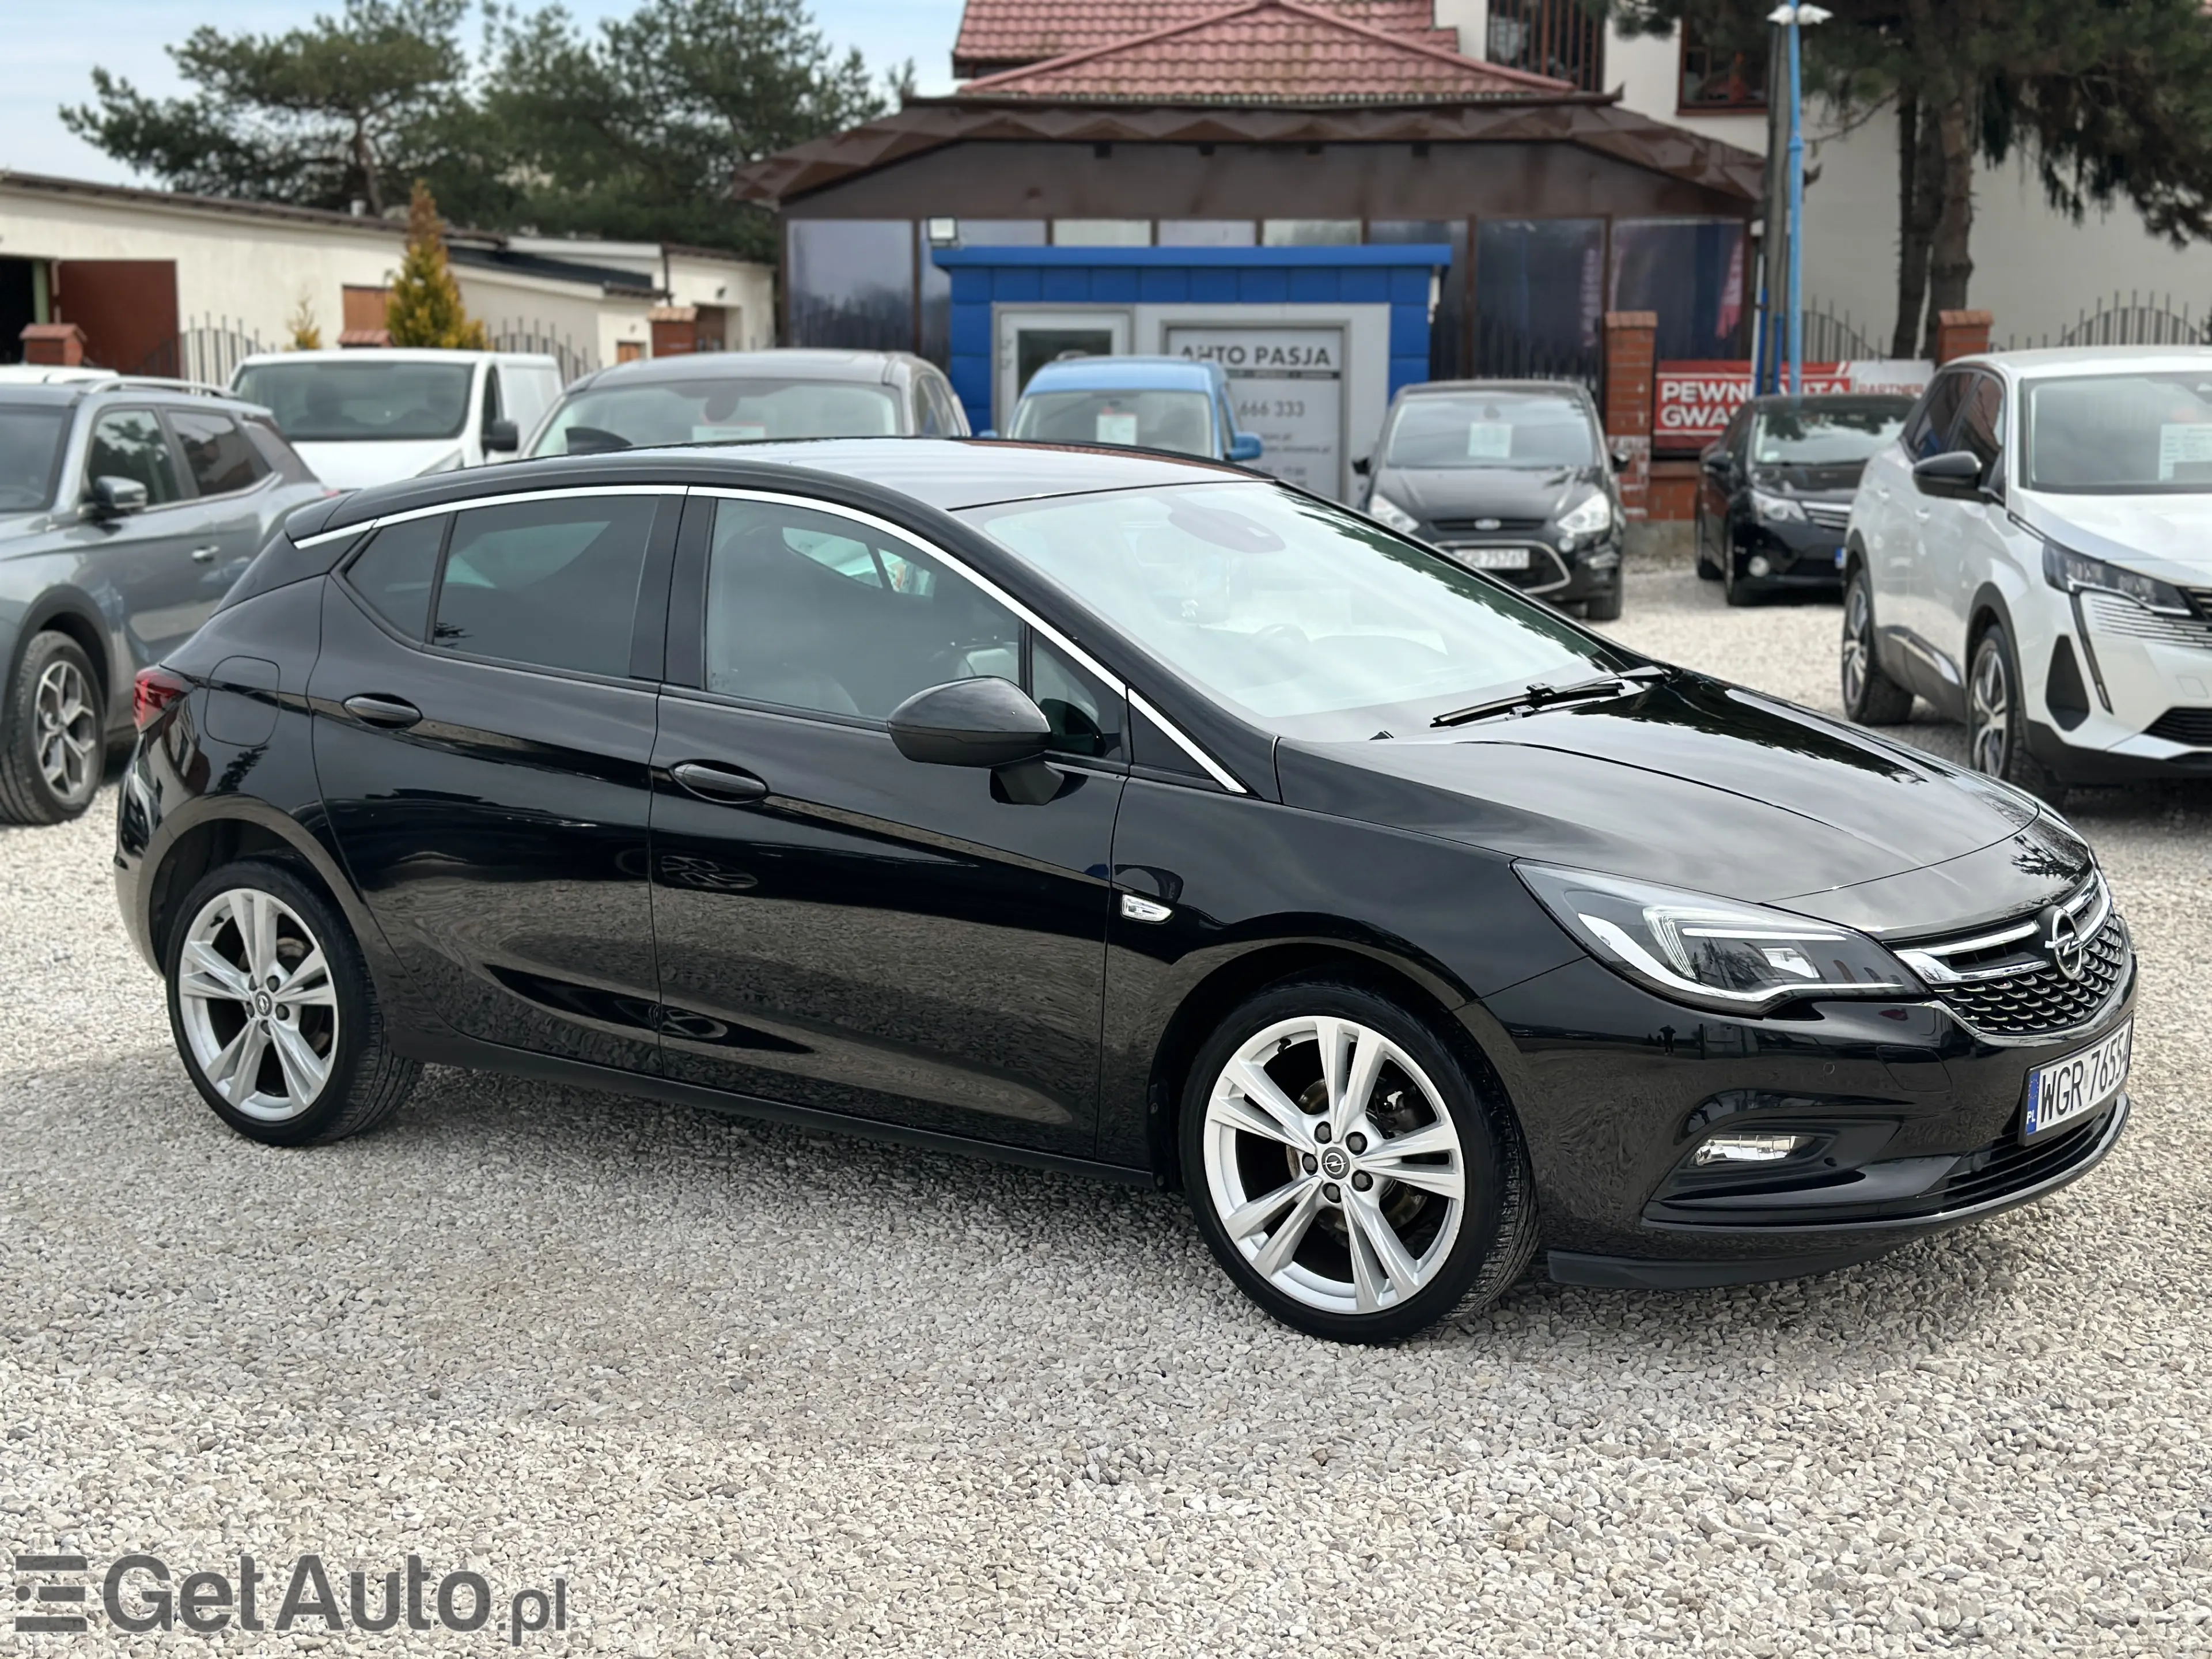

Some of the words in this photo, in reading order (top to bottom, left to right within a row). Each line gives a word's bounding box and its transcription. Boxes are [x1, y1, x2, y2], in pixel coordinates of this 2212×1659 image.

[1255, 345, 1331, 366] PASJA
[1274, 400, 1305, 418] 333
[1661, 404, 1740, 427] GWA
[2041, 1060, 2084, 1123] WGR
[2027, 1111, 2036, 1124] PL
